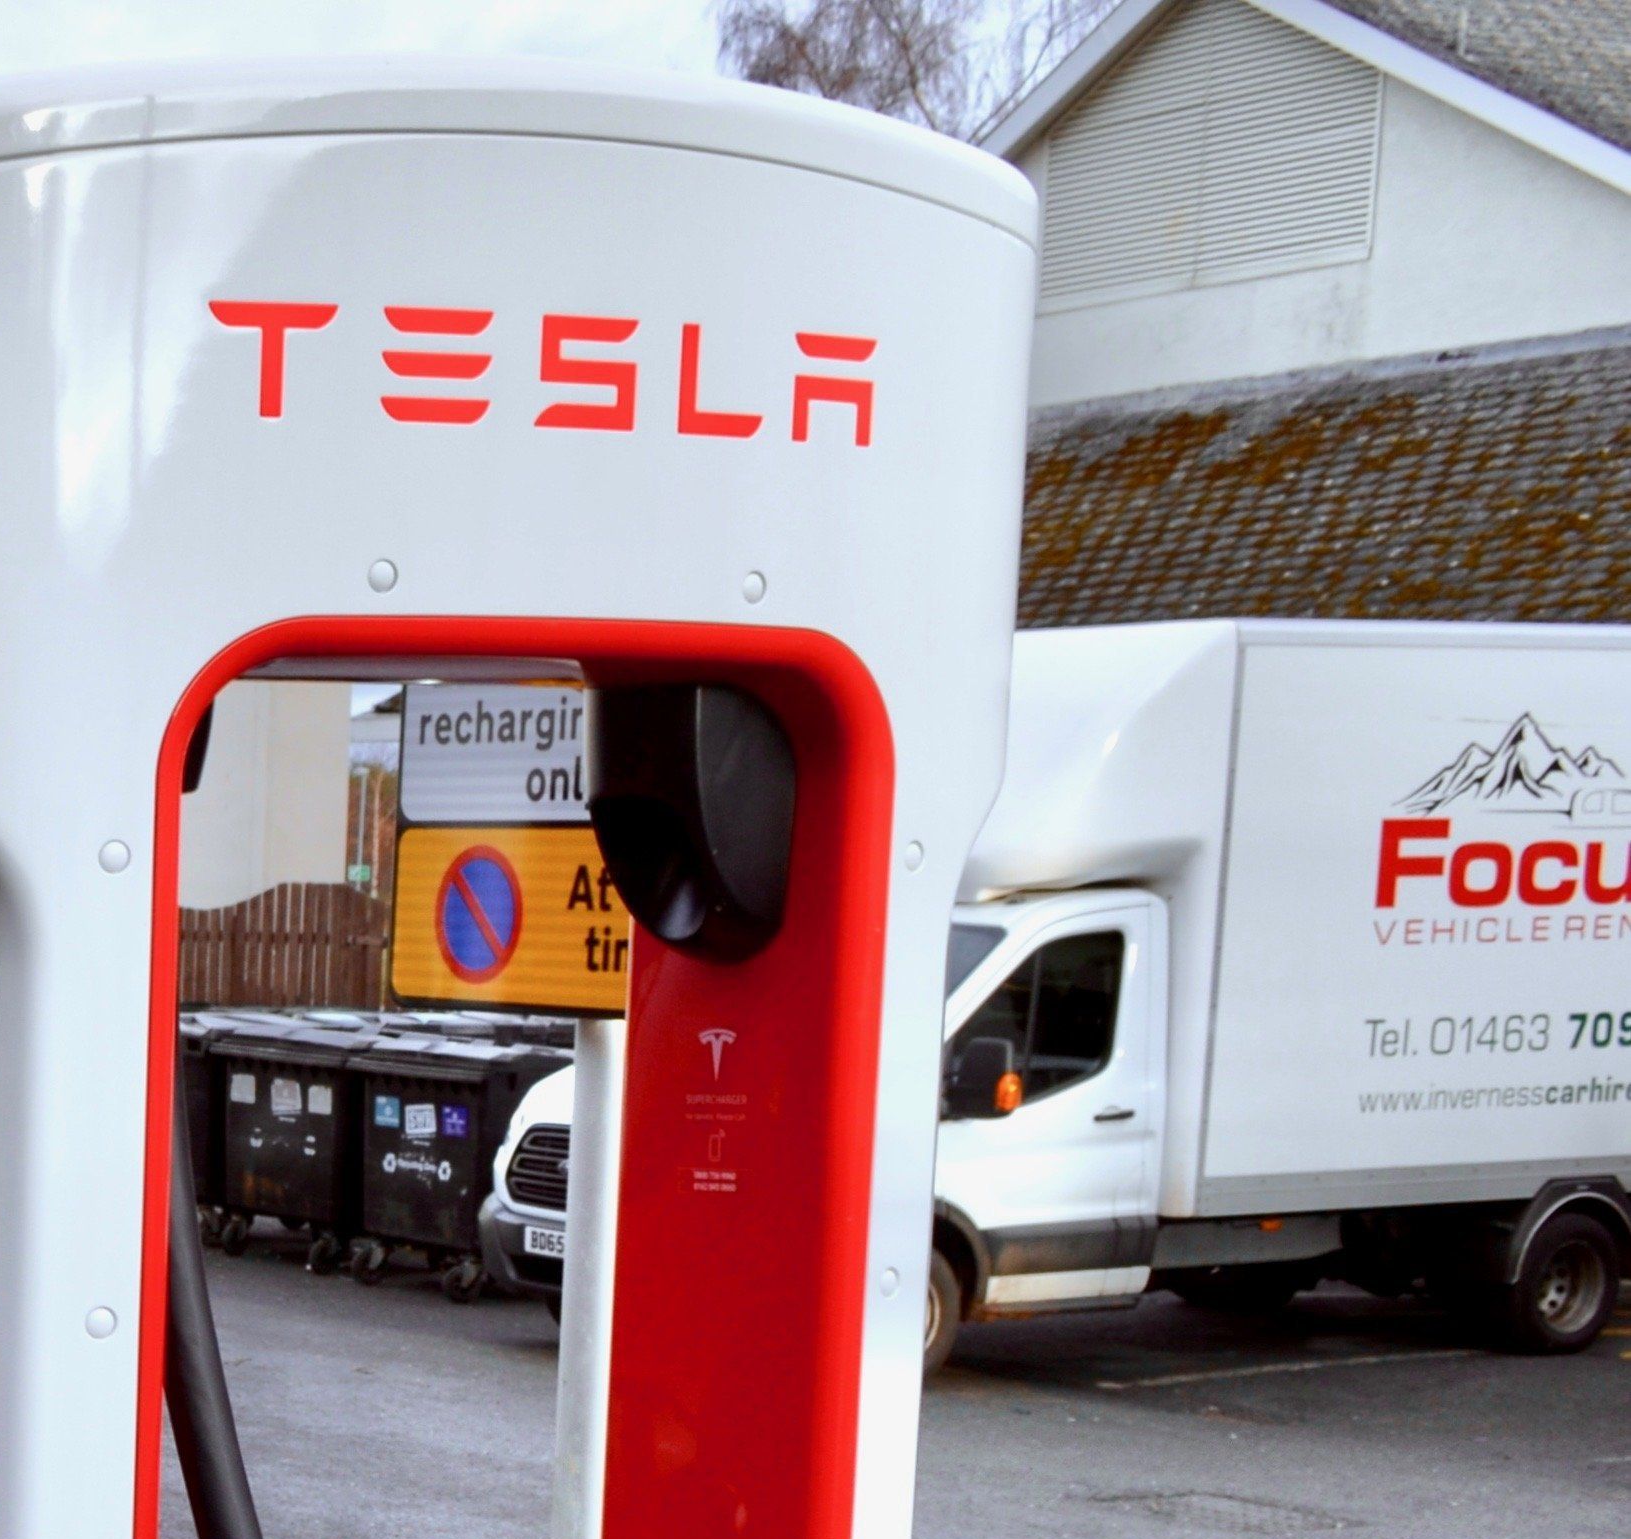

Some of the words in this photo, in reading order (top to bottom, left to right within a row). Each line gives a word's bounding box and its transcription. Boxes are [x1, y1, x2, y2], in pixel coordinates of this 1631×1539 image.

[208, 300, 878, 447] TESLA
[526, 756, 587, 806] onl
[567, 865, 613, 911] At
[1373, 915, 1551, 946] VEHICLE
[1365, 1018, 1419, 1057] Tel.
[1430, 1014, 1551, 1055] 01463
